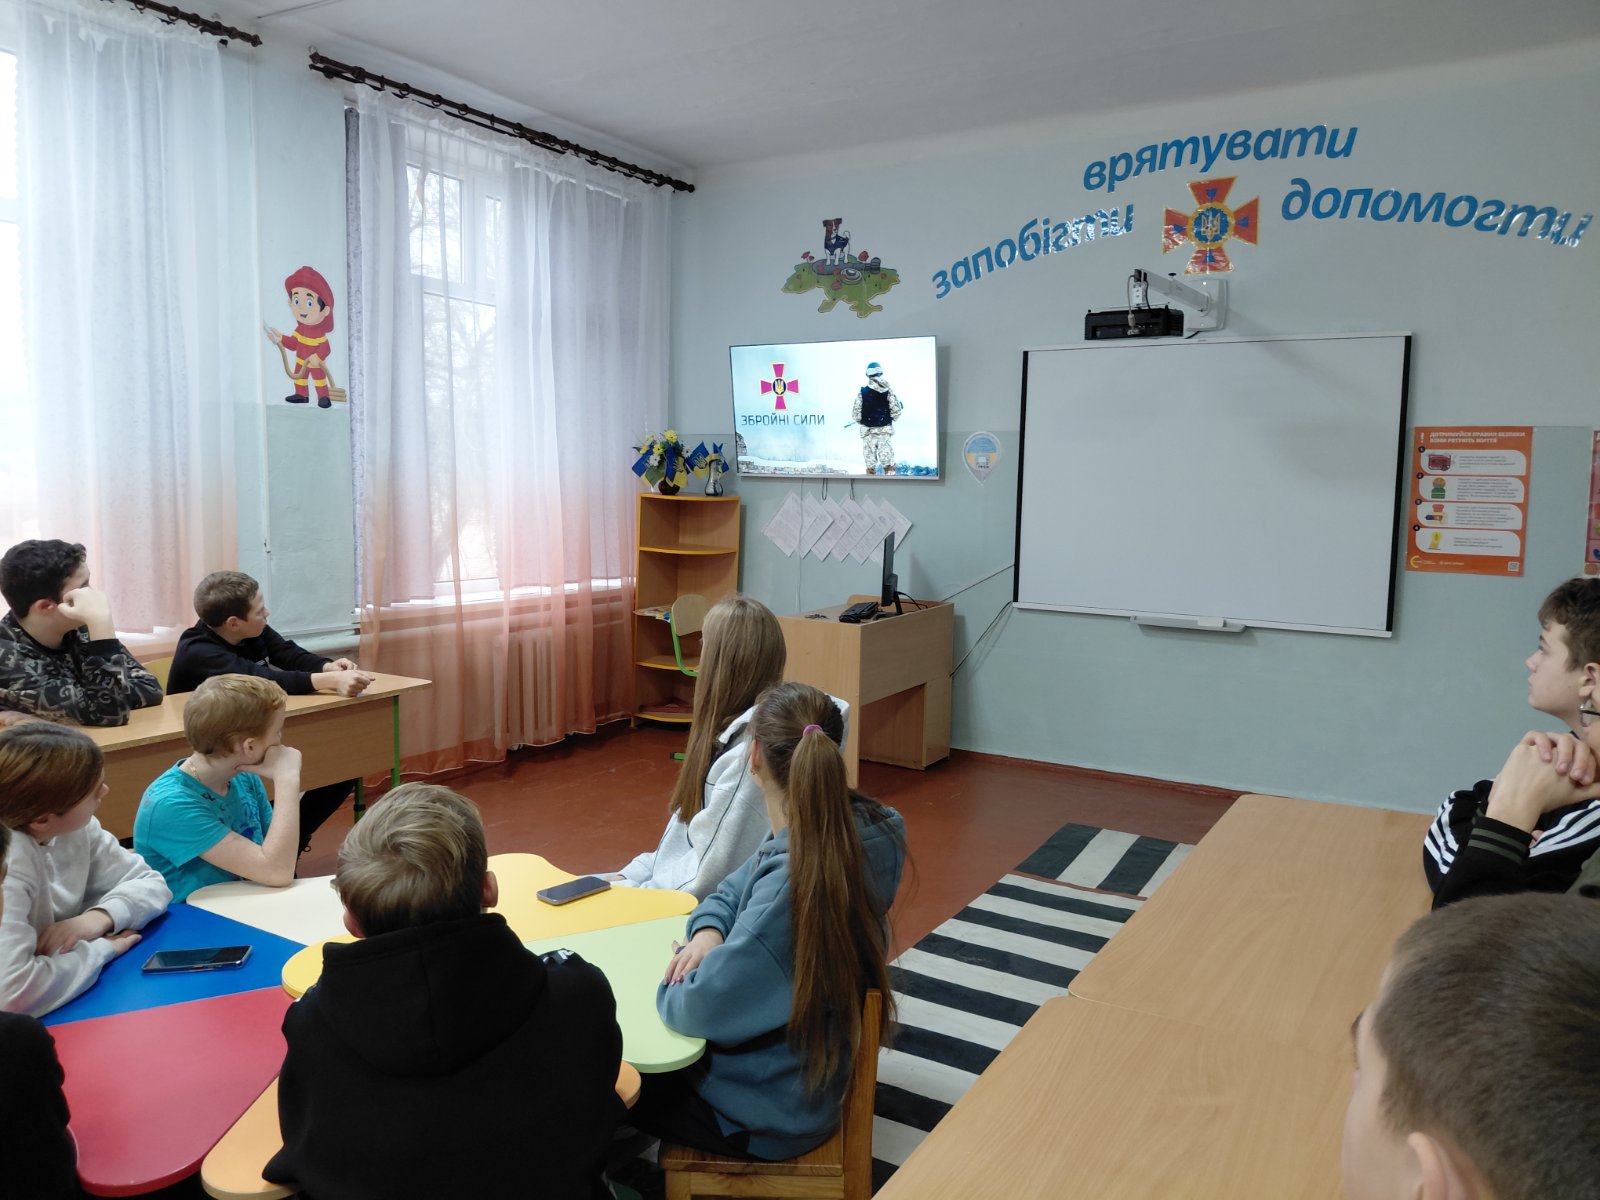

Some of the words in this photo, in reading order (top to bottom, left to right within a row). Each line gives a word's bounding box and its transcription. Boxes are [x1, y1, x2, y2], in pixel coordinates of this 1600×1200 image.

[1083, 125, 1358, 192] врятувати
[1282, 178, 1593, 248] допомогти
[931, 204, 1134, 299] запобігти
[741, 412, 789, 426] ЗБРОЙНІ
[793, 414, 825, 425] СИЛИ
